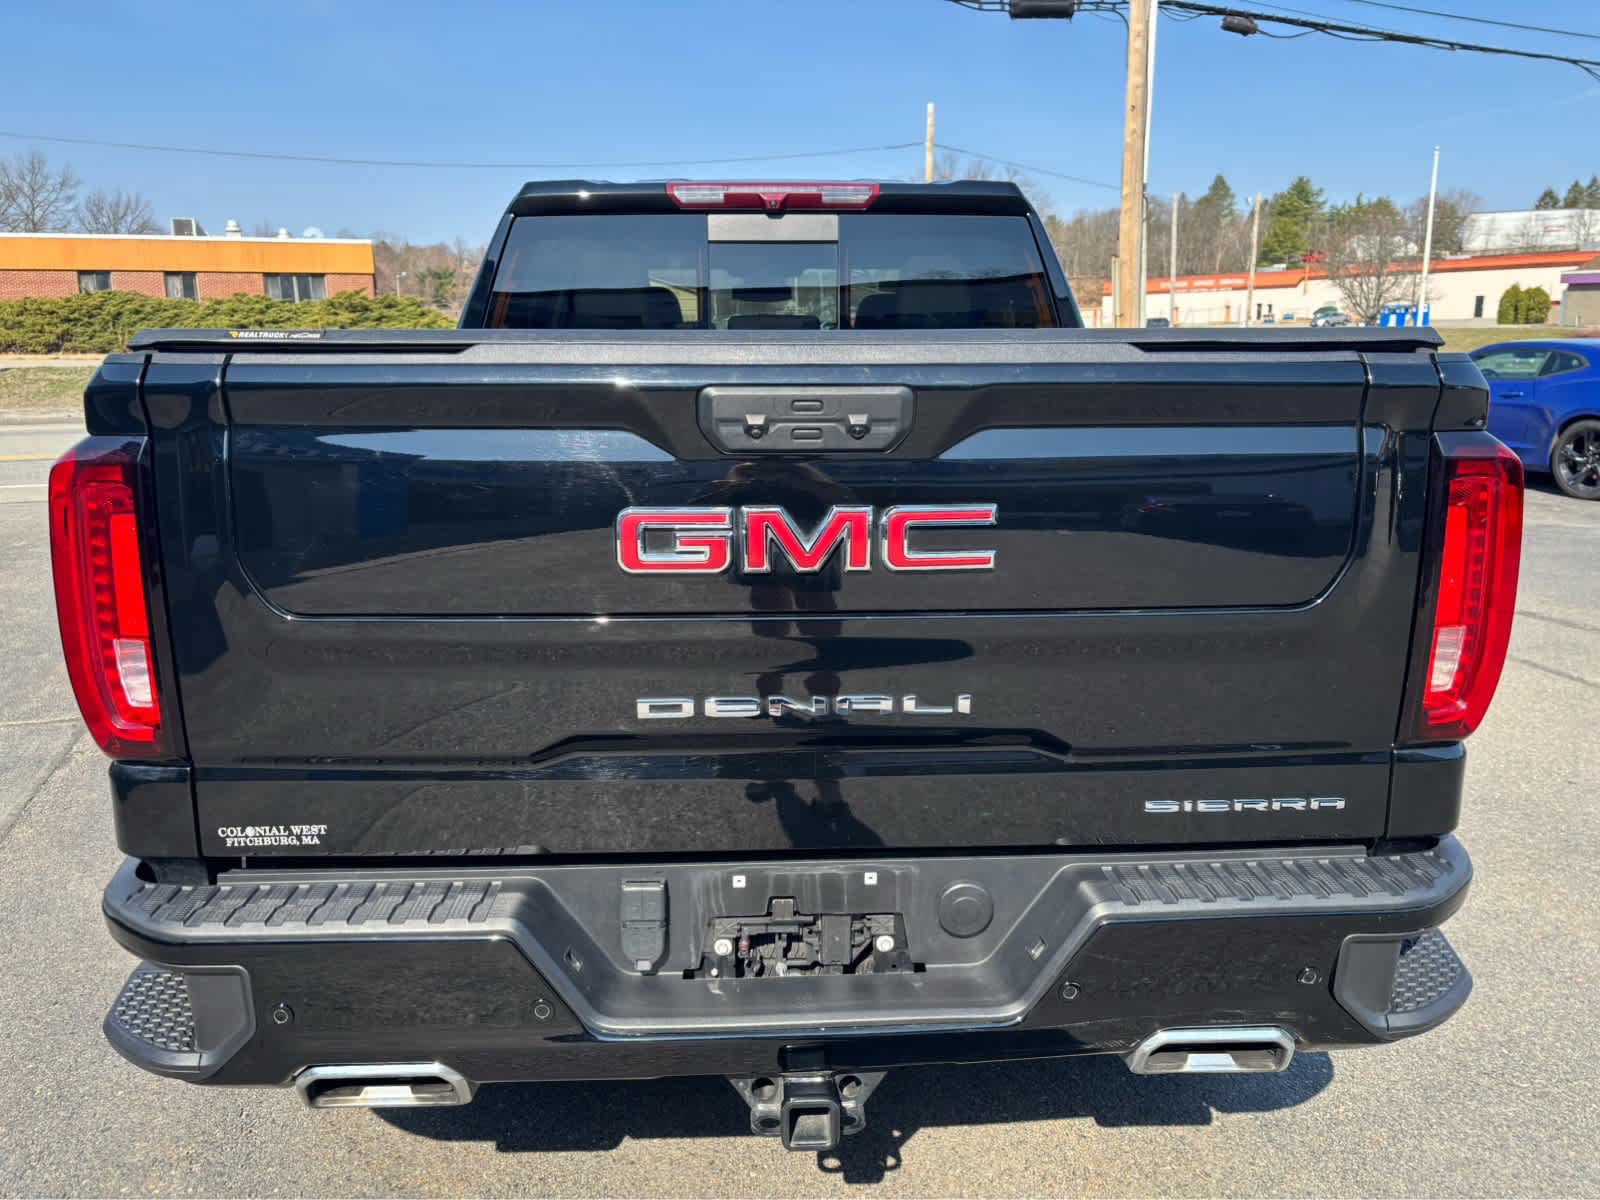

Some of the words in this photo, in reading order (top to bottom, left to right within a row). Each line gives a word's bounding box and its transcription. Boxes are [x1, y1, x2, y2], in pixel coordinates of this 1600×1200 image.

[617, 504, 998, 573] GMC
[637, 695, 971, 718] DENALI
[1144, 797, 1346, 812] SIERRA
[218, 826, 288, 837] COLONIAL
[290, 825, 327, 835] WEST
[226, 836, 299, 847] FITCHBURG,
[302, 836, 320, 845] MA
